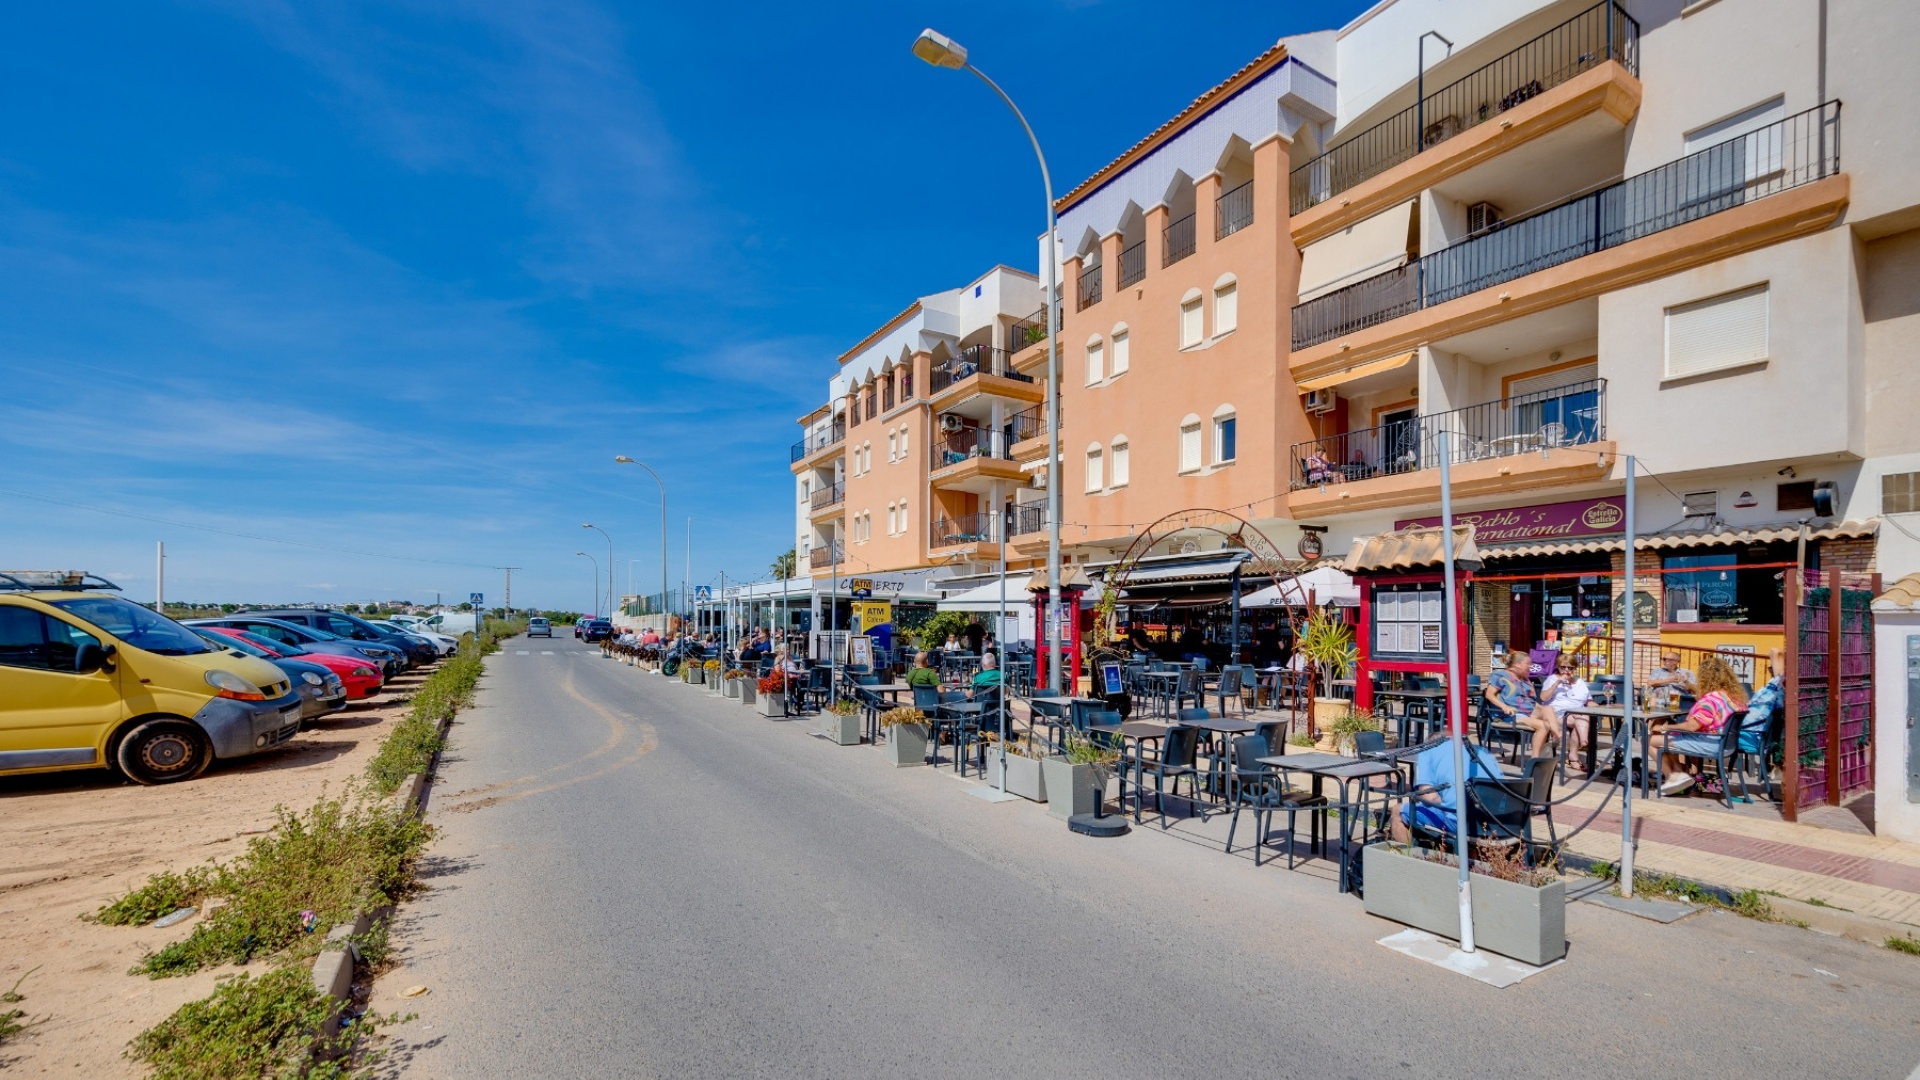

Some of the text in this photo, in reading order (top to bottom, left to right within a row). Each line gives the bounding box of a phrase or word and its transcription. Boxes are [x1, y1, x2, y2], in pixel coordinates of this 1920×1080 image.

[1474, 518, 1577, 541] ernational
[840, 579, 904, 591] CIERTO
[867, 607, 884, 615] ATM
[1722, 648, 1750, 657] ONE
